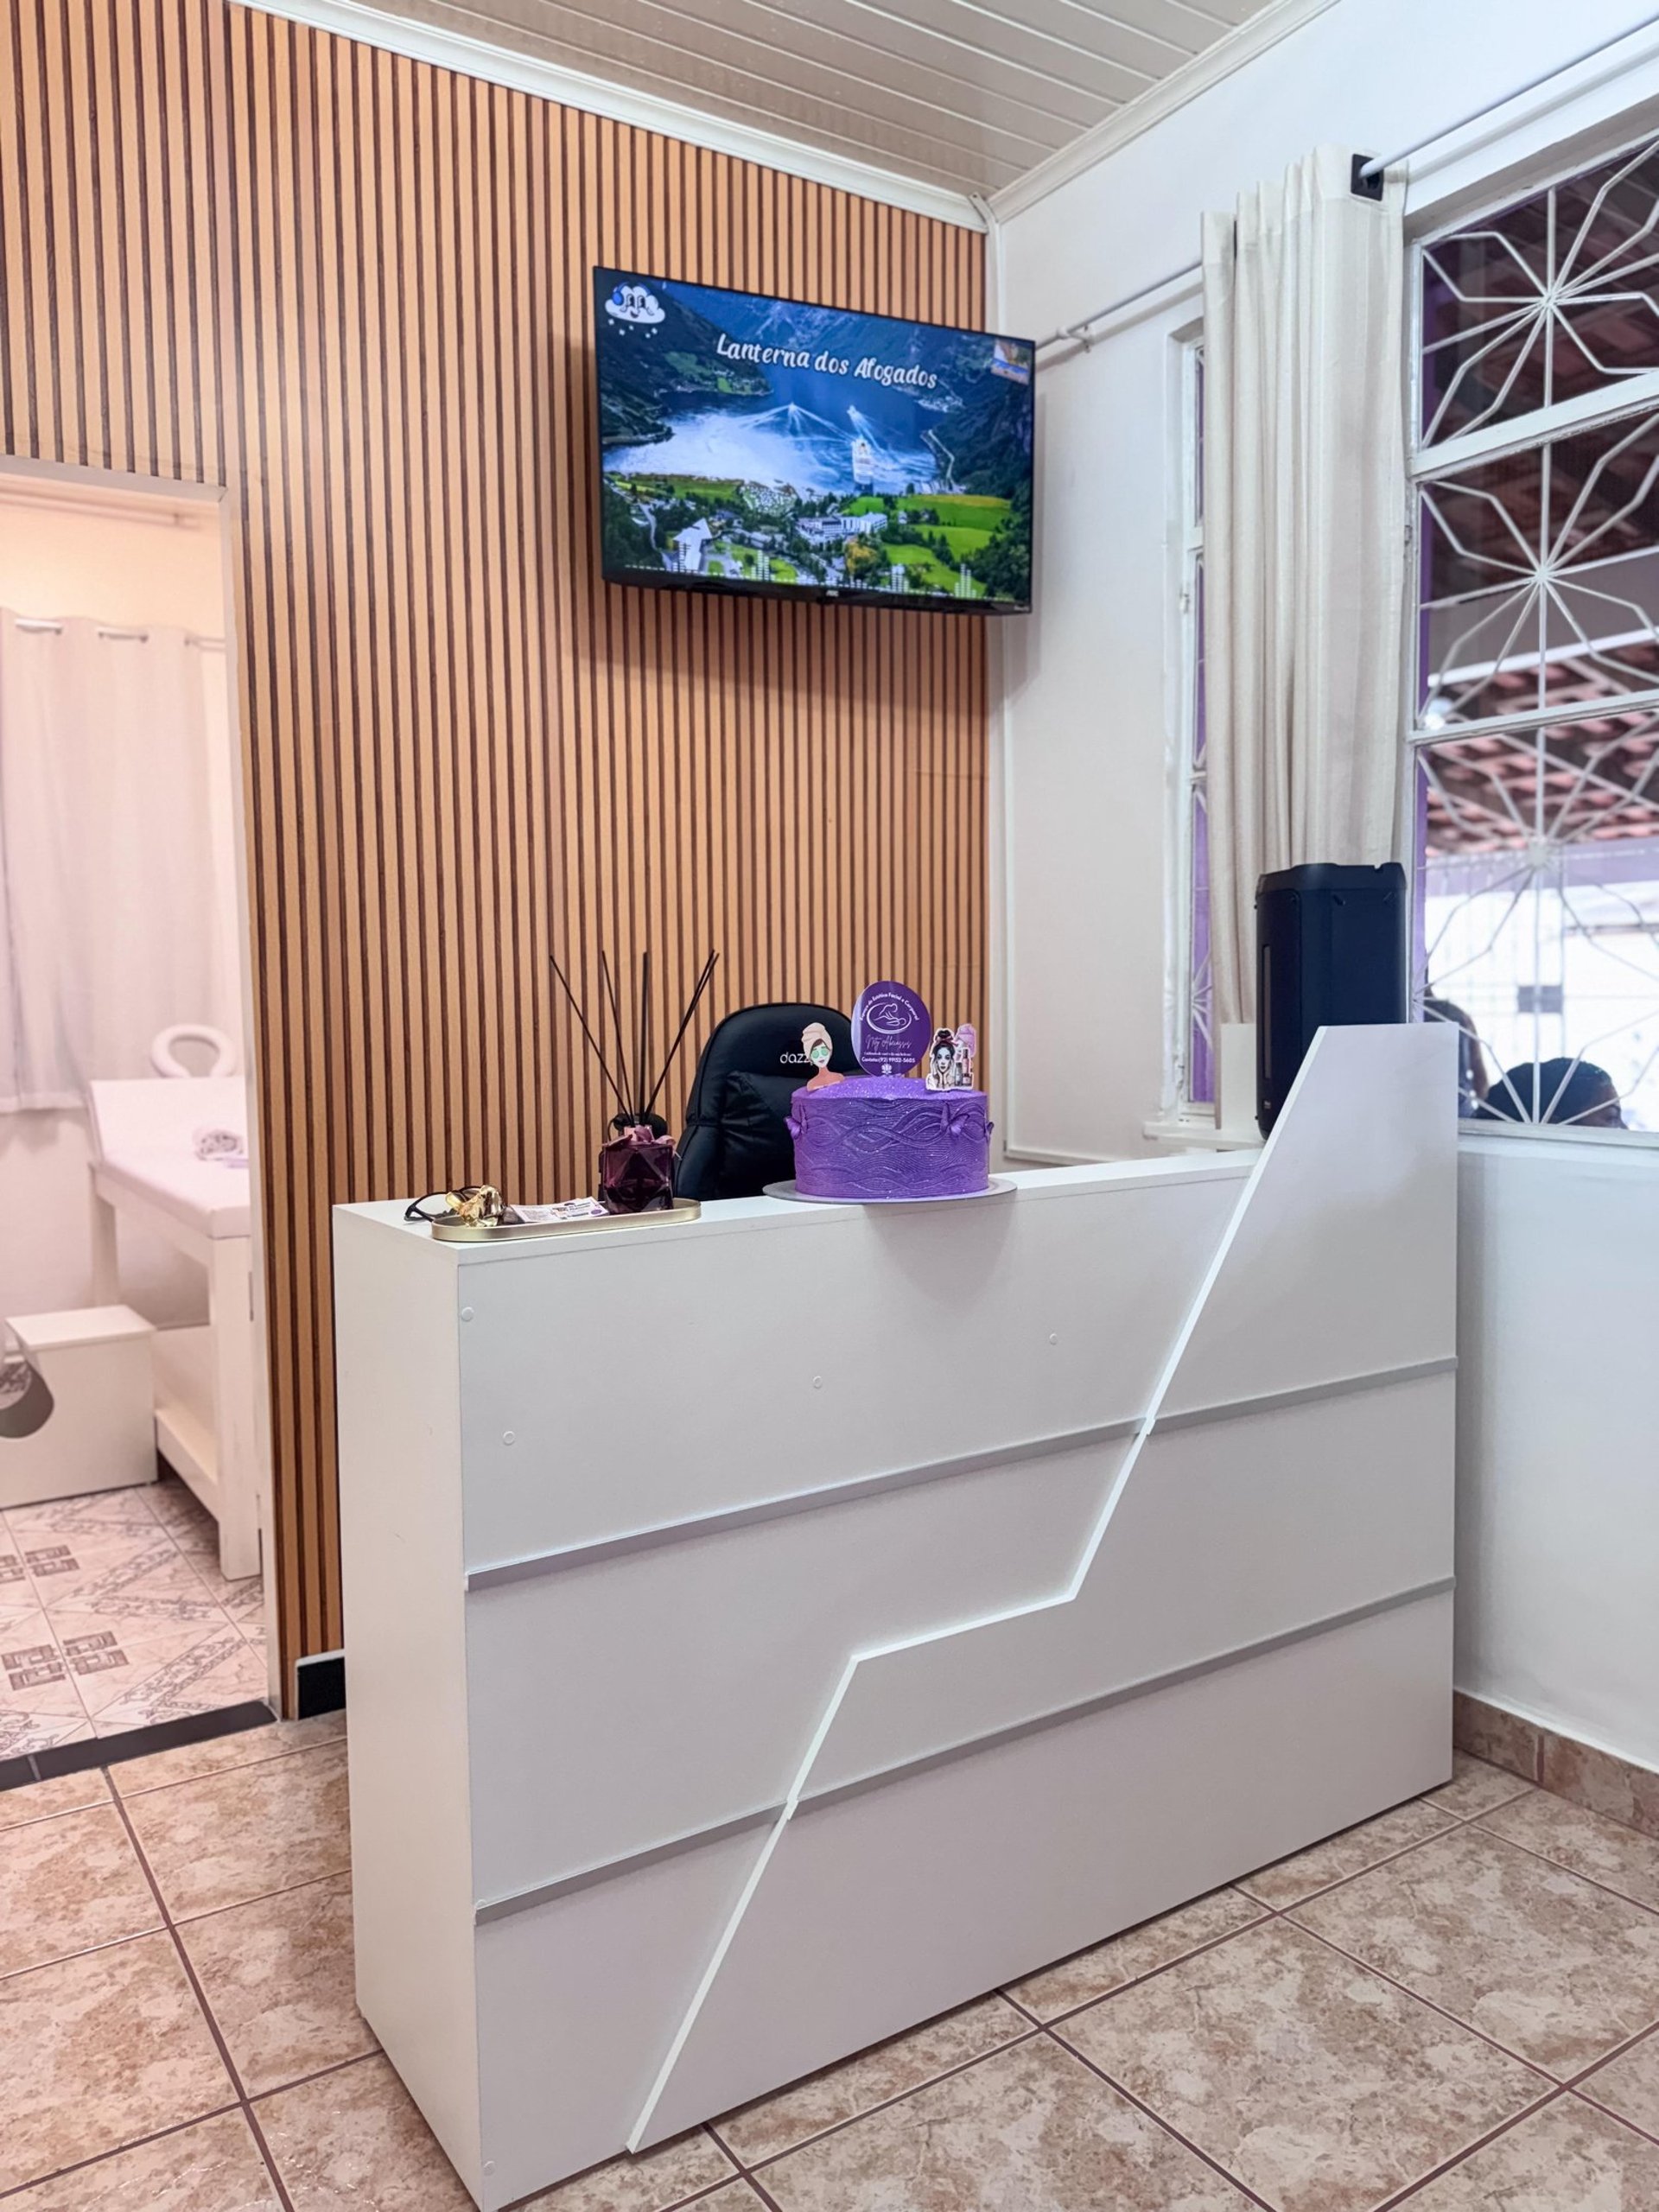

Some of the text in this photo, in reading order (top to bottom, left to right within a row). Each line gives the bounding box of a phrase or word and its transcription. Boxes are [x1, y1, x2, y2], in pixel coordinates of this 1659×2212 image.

[716, 333, 938, 389] Lanterna dos Afogados
